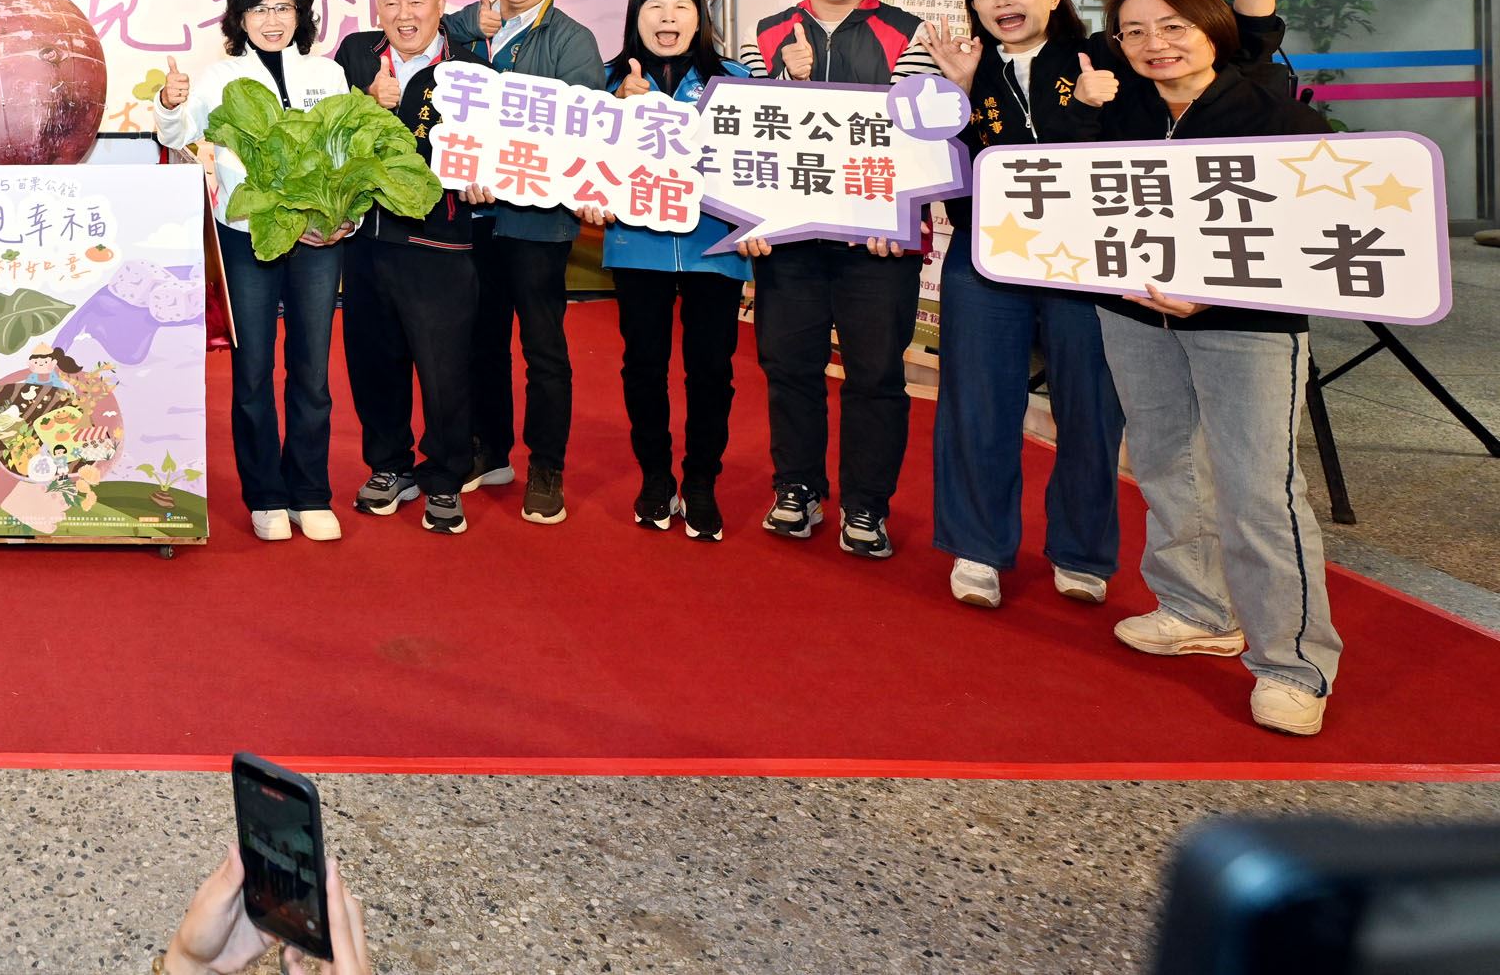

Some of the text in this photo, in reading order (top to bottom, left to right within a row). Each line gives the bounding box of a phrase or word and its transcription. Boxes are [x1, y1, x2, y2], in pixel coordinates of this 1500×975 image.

[441, 69, 691, 160] 芋頭的家
[710, 104, 895, 148] 苗栗公館
[16, 176, 80, 199] 苗栗公館
[438, 132, 695, 223] 苗栗公館
[1002, 155, 1278, 223] 芋頭界
[1094, 223, 1406, 299] 的王者
